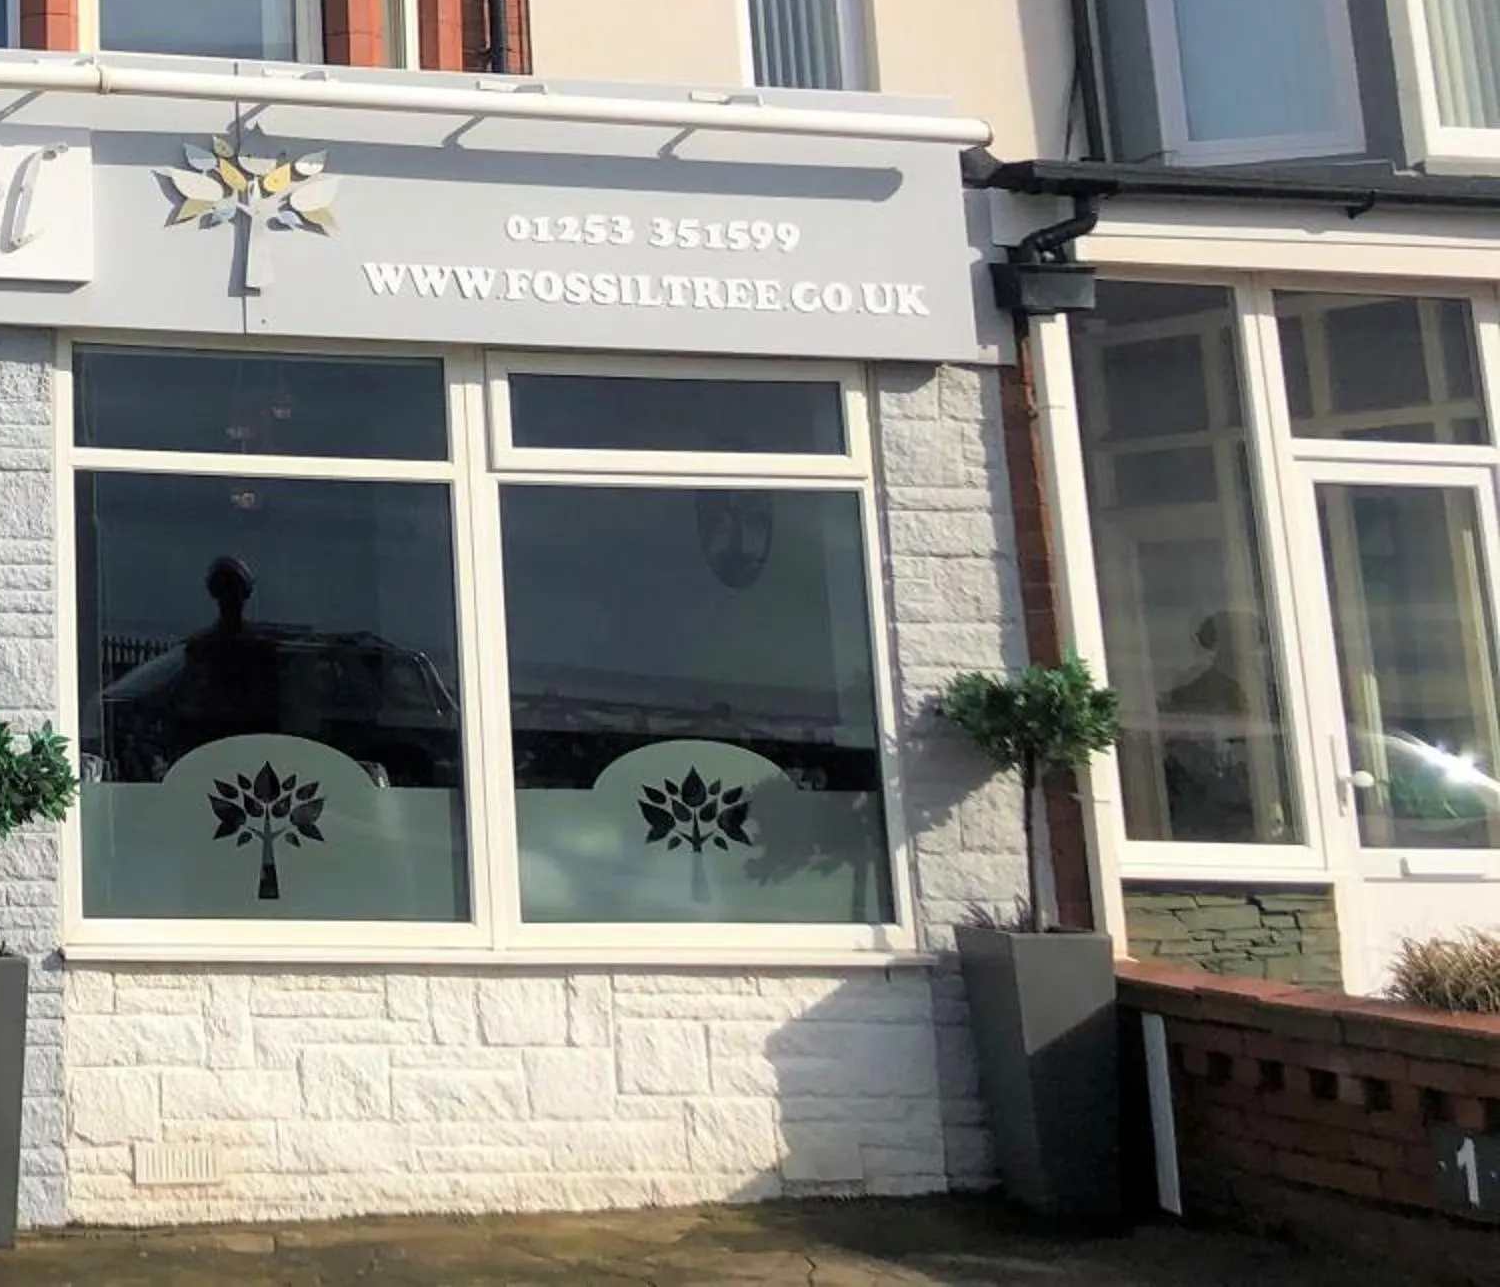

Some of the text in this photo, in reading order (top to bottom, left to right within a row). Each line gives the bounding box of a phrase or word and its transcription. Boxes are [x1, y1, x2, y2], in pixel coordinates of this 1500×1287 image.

[505, 213, 802, 253] 01253 351599
[362, 262, 930, 317] WWW.FOSSILTREE.CO.UK
[1456, 1136, 1480, 1209] 1
